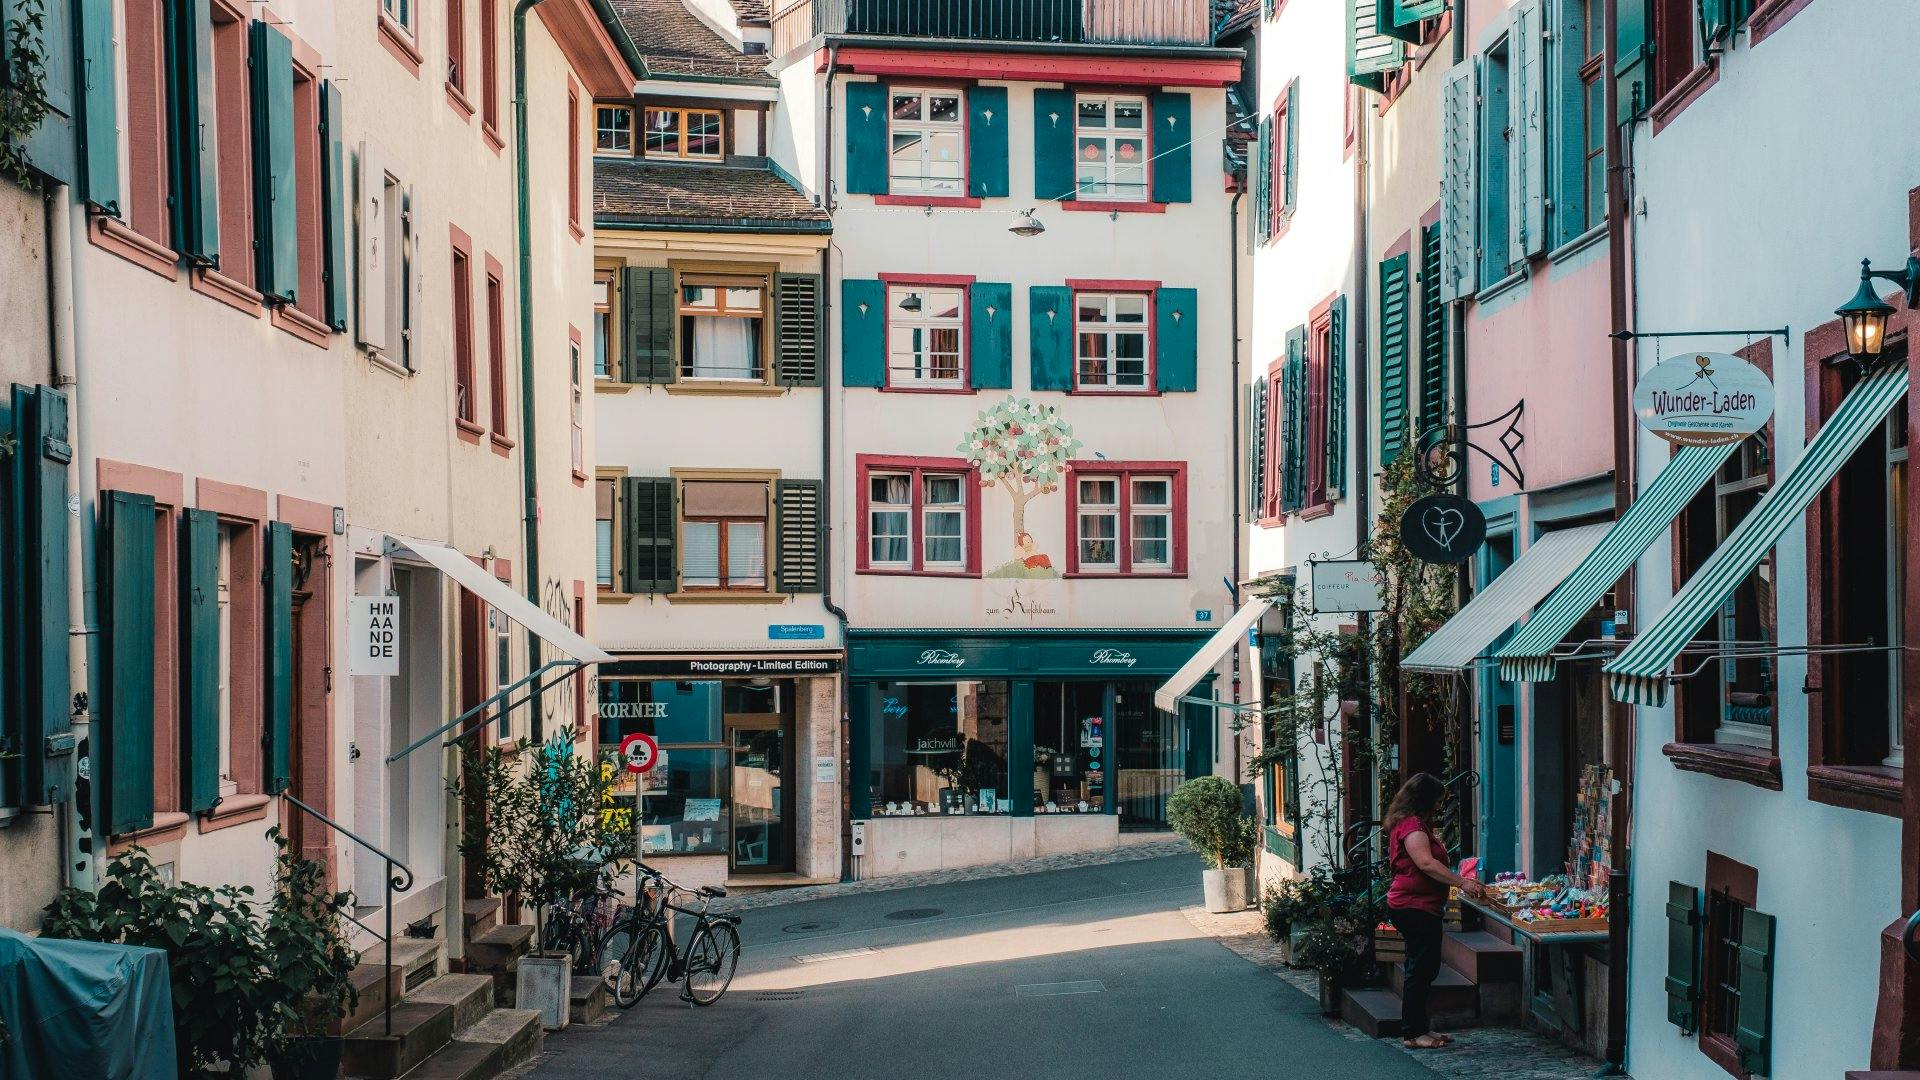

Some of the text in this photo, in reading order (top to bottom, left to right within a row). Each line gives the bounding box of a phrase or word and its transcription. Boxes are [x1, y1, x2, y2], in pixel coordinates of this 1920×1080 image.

[1652, 390, 1756, 416] Wunder-Laden
[1665, 431, 1739, 444] www.wunder-laden.ch
[780, 625, 813, 634] Spalenberg
[794, 660, 829, 670] Edition
[917, 649, 965, 669] Rhomberg
[1089, 648, 1137, 668] Rhomberg
[598, 702, 669, 719] KORNER
